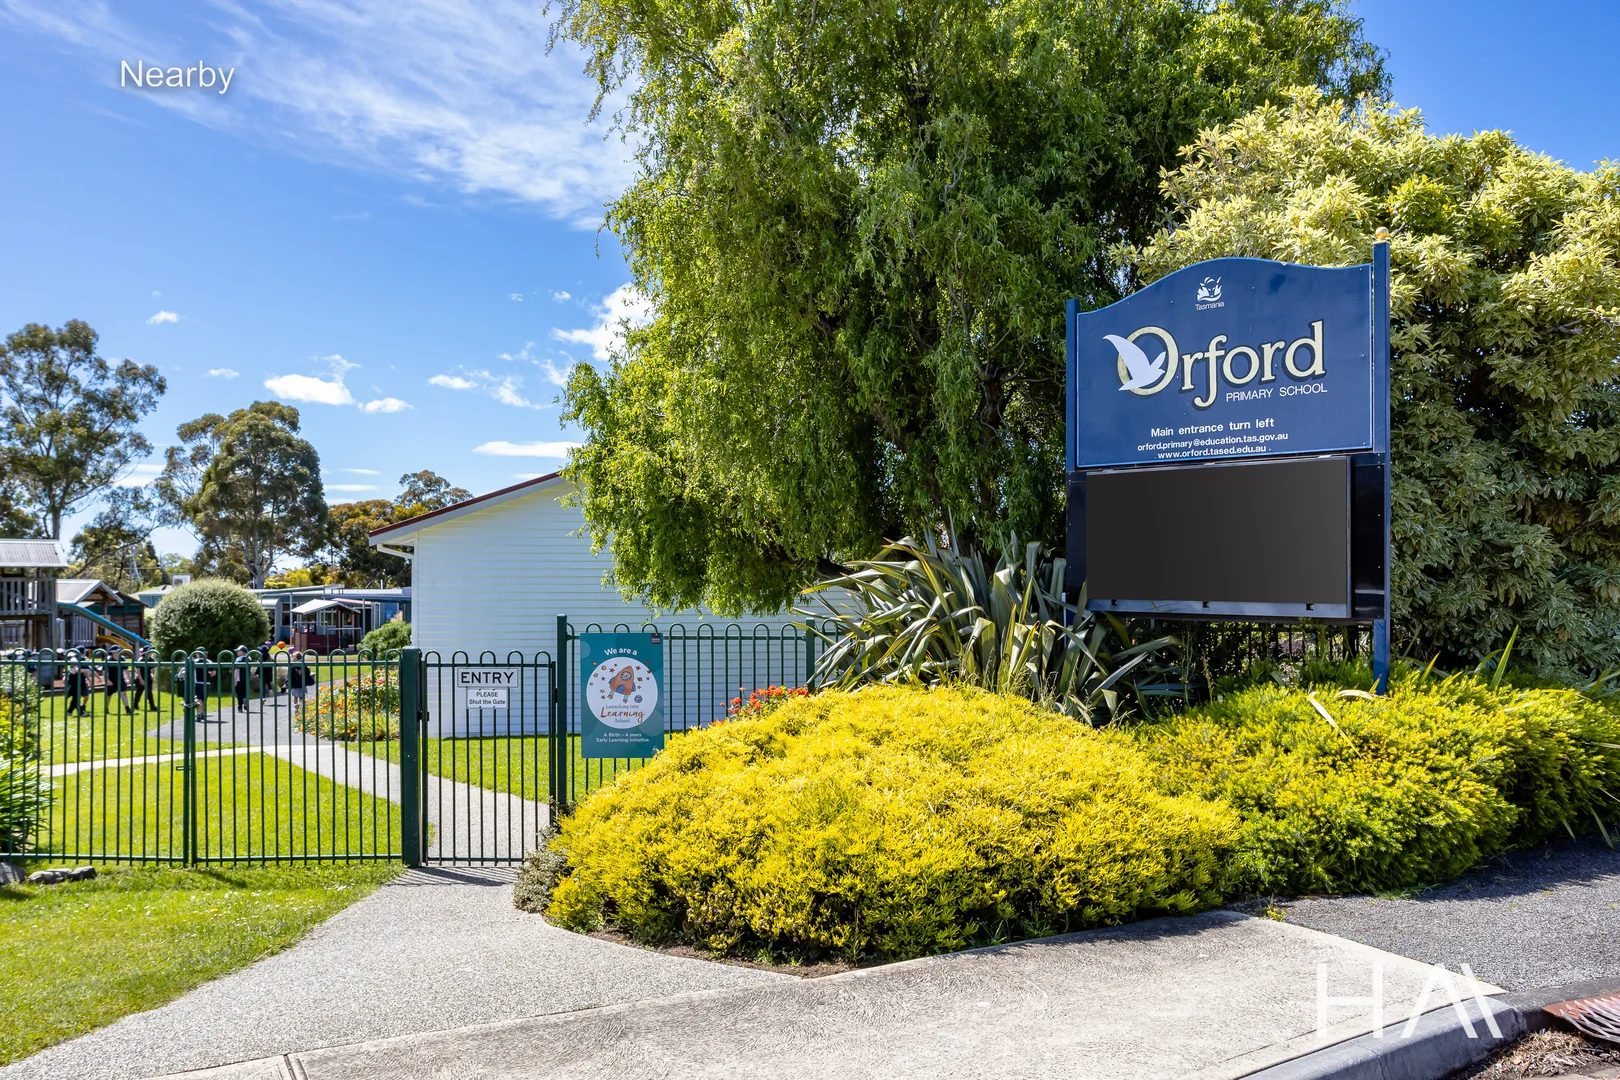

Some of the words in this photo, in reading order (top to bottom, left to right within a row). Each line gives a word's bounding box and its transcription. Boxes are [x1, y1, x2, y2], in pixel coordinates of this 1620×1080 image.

[1195, 301, 1225, 311] Tasmania
[1116, 319, 1327, 408] Orford
[1226, 388, 1273, 402] PRIMARY
[1279, 383, 1328, 397] SCHOOL
[1151, 428, 1174, 437] Main
[1178, 423, 1224, 435] entrance
[1229, 421, 1251, 431] turn
[1255, 418, 1275, 428] left
[1137, 432, 1288, 451] orford.primary@education.tas.gov.au
[1157, 444, 1267, 459] www.orford.tased.edu.au
[604, 647, 618, 656] We
[461, 671, 514, 684] ENTRY
[600, 706, 645, 723] Learning
